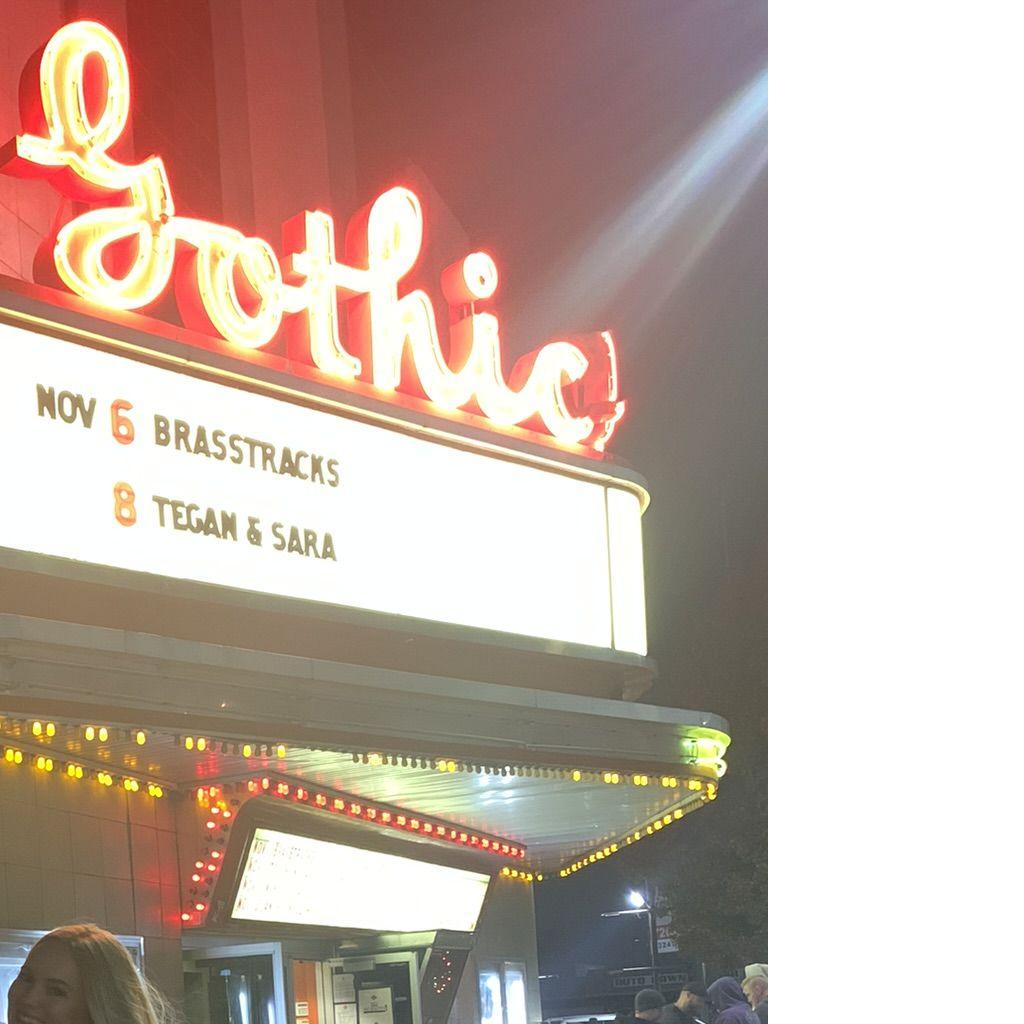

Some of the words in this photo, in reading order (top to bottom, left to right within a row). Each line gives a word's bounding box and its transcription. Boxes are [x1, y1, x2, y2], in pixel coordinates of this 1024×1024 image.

[13, 19, 626, 453] Gothic
[36, 383, 97, 429] NOV
[110, 399, 135, 445] 6
[154, 414, 339, 487] BRASSTRACKS
[113, 480, 137, 527] 8
[152, 495, 237, 541] TEGAN
[247, 516, 262, 546] &
[272, 522, 337, 561] SARA
